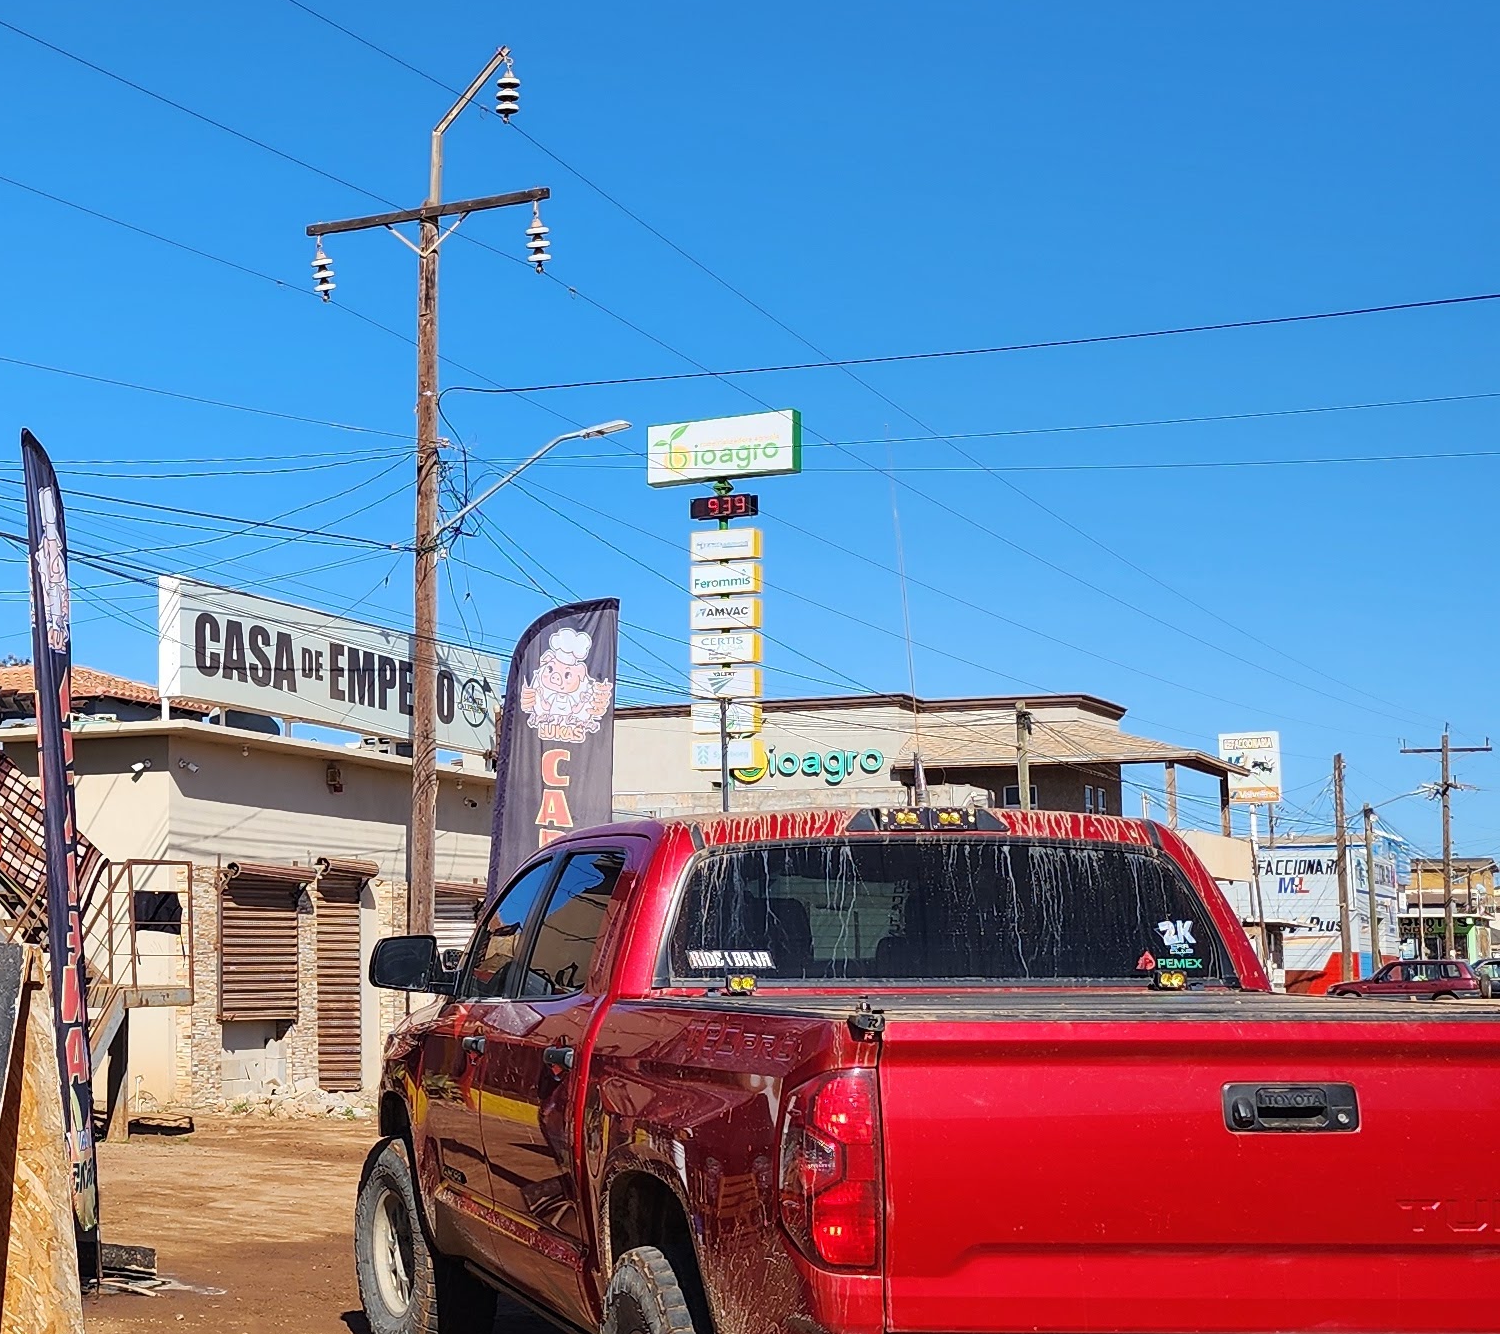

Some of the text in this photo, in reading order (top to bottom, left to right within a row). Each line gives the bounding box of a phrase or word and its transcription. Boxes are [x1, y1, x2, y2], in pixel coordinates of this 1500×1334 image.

[668, 441, 779, 469] bioagro
[695, 576, 750, 589] Ferommis
[706, 606, 749, 617] AMVAC
[701, 636, 744, 646] CERTIS
[195, 613, 455, 725] CASA DE EMPEO
[539, 724, 585, 741] LUKAS
[737, 745, 885, 786] ioagro
[690, 951, 772, 967] RIDE BAJA
[1157, 958, 1203, 969] PEMEX
[1263, 1093, 1323, 1108] TOYOTA
